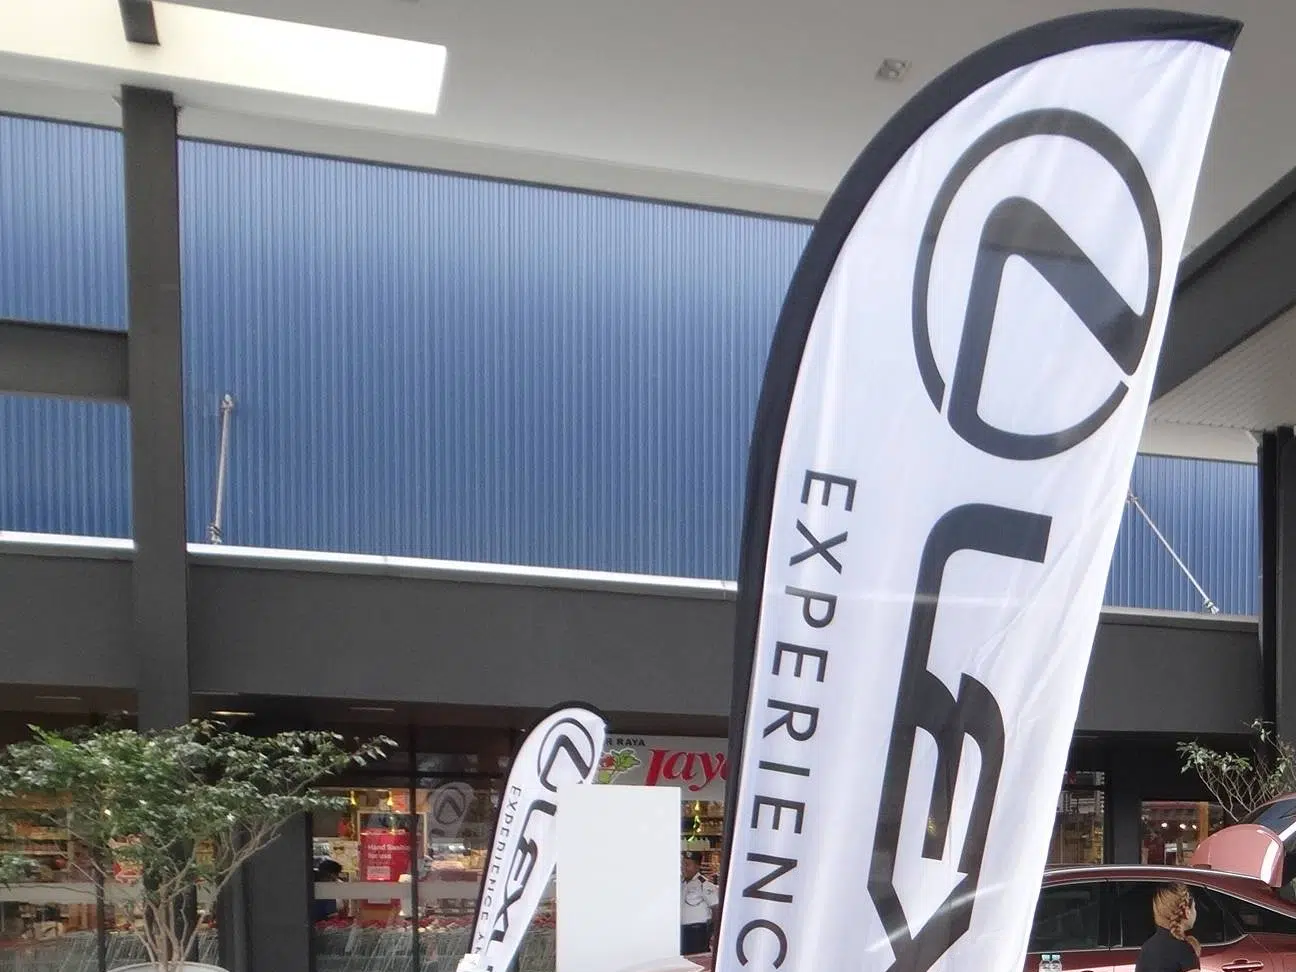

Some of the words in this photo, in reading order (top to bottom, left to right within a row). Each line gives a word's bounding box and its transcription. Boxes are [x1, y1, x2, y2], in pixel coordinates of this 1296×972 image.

[617, 739, 646, 747] RAYA
[645, 749, 729, 792] Jay
[480, 785, 521, 920] EXPERIENCE
